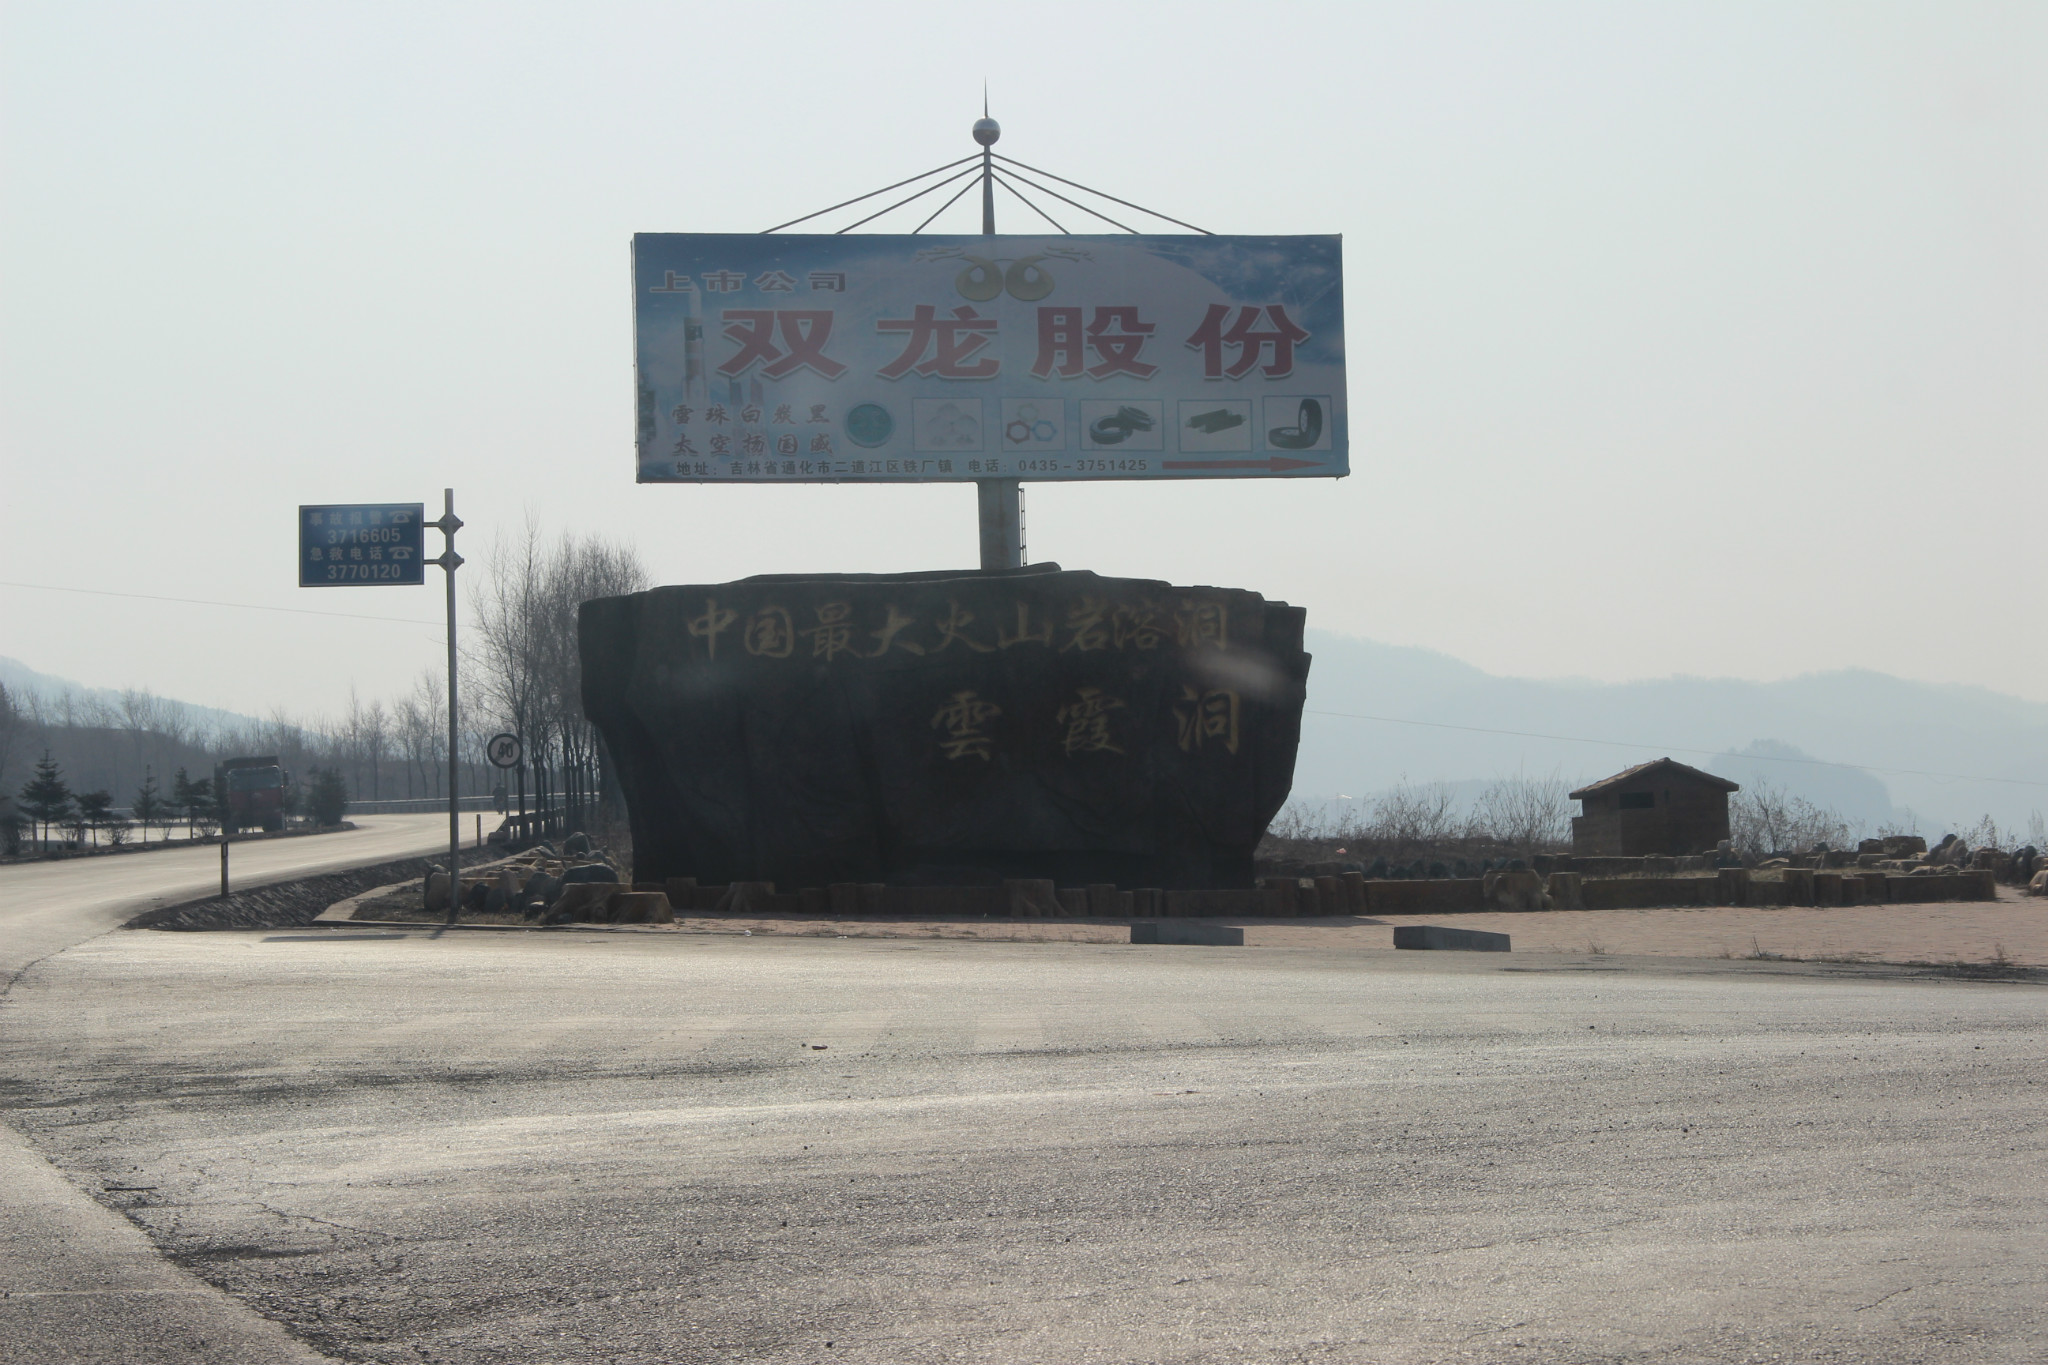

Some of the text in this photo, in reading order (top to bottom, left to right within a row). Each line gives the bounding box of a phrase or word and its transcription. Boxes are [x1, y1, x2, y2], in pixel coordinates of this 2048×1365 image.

[649, 270, 848, 294] 上市公司
[716, 303, 1312, 380] 双龙股份
[672, 433, 834, 456] 太空扬国威
[327, 528, 401, 544] 3716605
[309, 546, 383, 561] 急救电话
[327, 564, 401, 580] 3770120
[686, 597, 1230, 661] 中国最大火山岩溶洞
